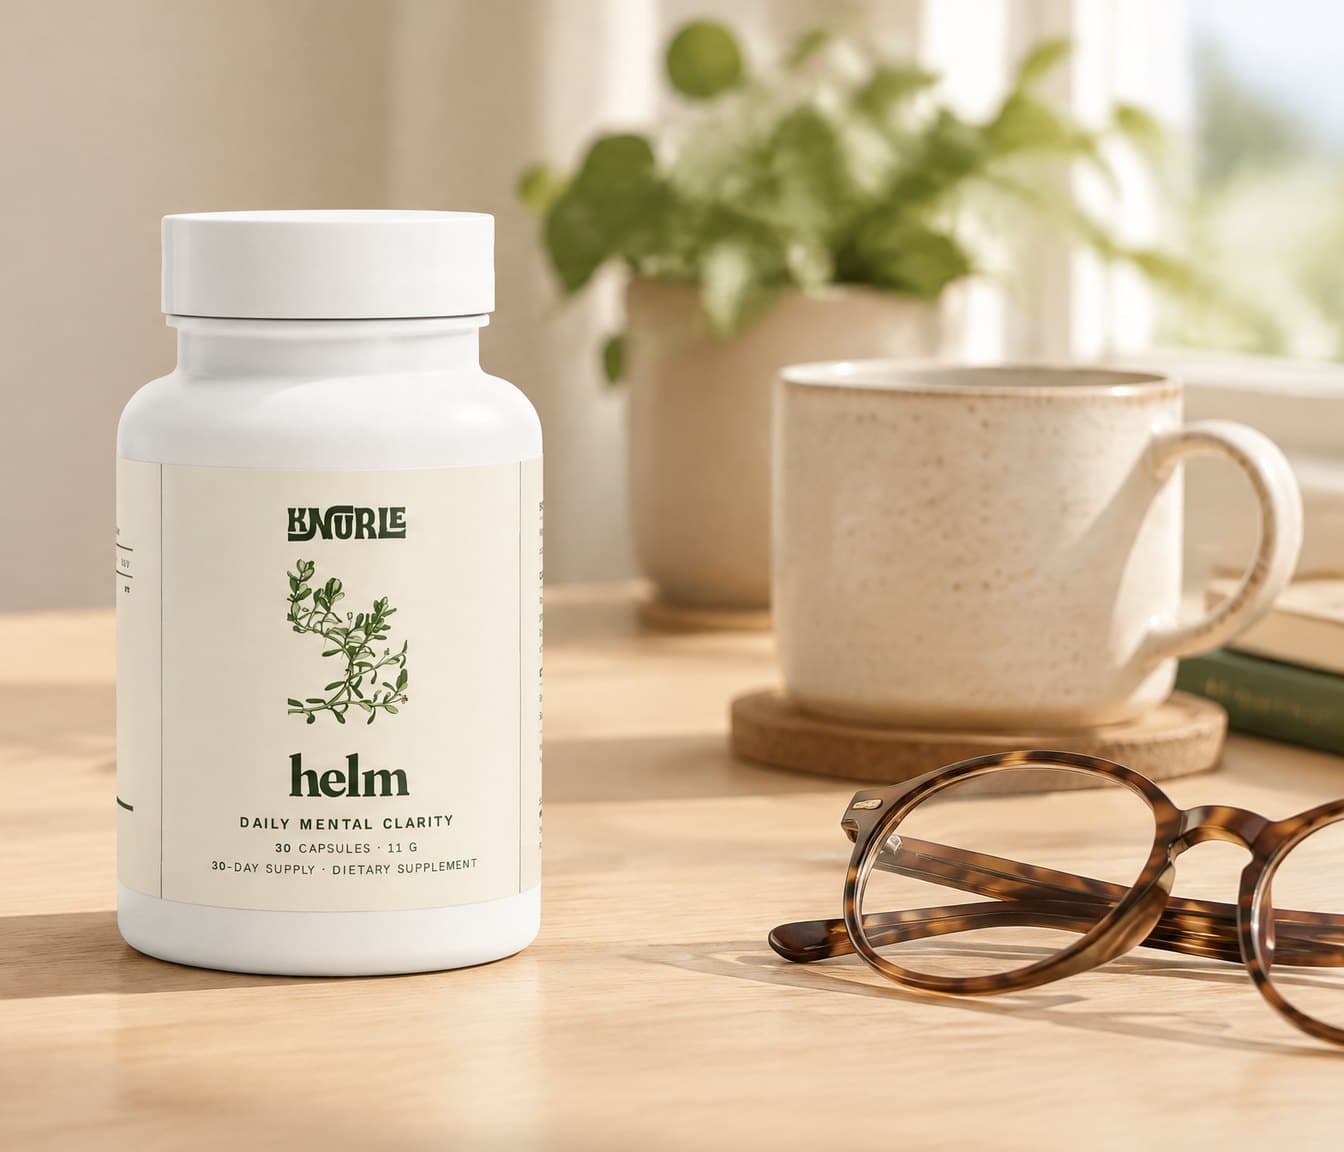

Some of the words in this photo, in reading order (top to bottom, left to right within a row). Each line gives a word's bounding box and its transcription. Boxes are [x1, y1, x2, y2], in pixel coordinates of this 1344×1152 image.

[287, 504, 407, 543] KNURLE
[288, 752, 411, 798] helm
[239, 816, 290, 830] DAILY
[299, 817, 373, 831] MENTAL
[382, 814, 453, 830] CLARITY
[275, 842, 292, 854] 30
[298, 843, 371, 854] CAPSULES
[387, 842, 403, 854] 11
[408, 841, 418, 853] G
[211, 860, 260, 873] 30-DAY
[265, 863, 315, 875] SUPPLY
[332, 863, 391, 875] DIETARY
[397, 857, 478, 874] SUPPLEMENT
